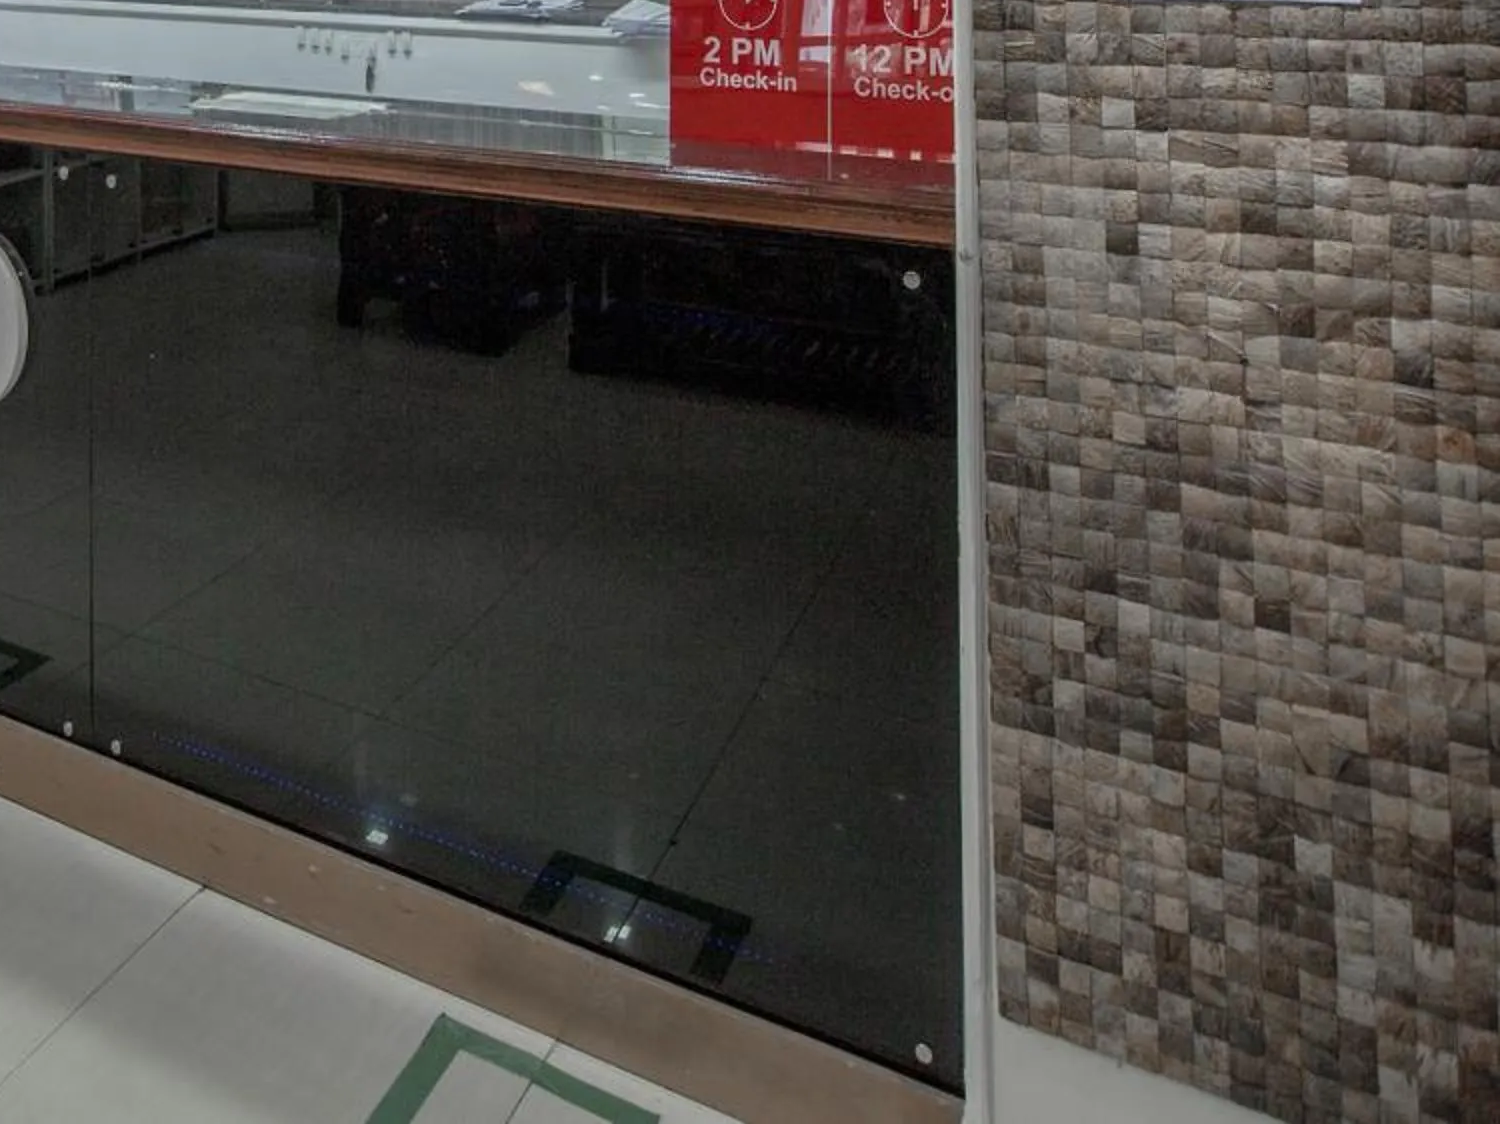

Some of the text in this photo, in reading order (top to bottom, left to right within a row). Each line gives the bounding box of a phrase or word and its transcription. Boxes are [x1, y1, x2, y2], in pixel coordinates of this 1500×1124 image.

[703, 36, 781, 67] 2 PM
[853, 44, 955, 77] 12 PM
[700, 67, 798, 92] Check-in
